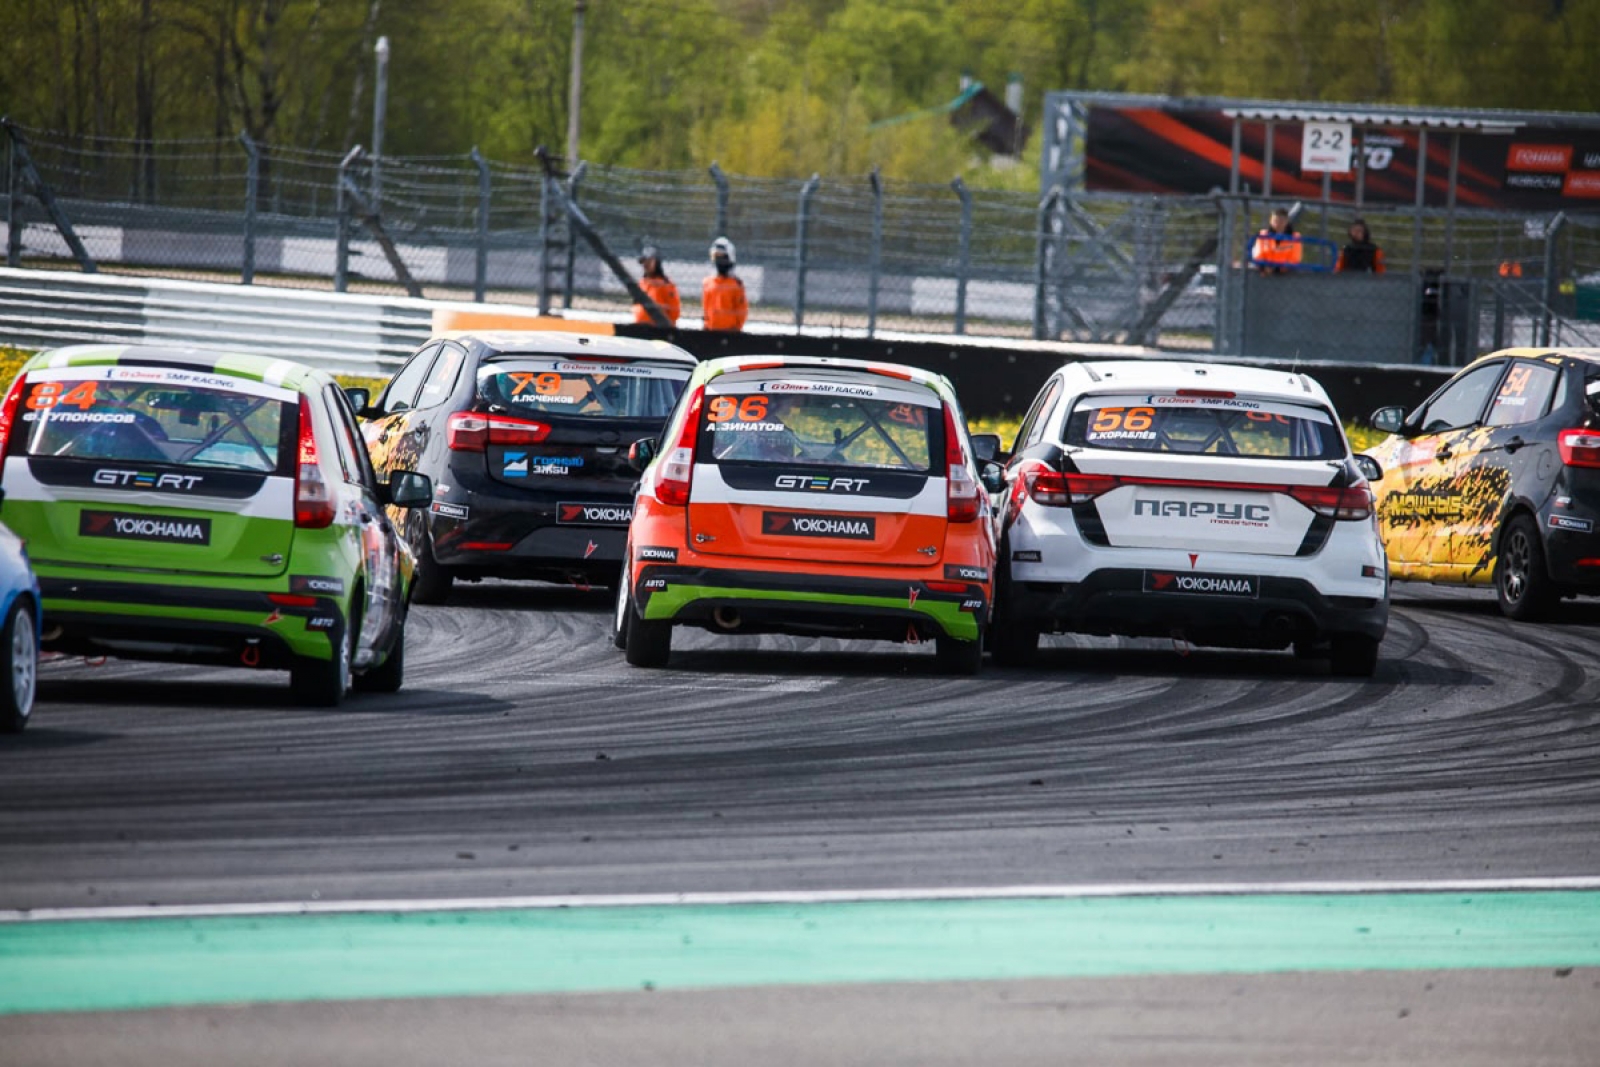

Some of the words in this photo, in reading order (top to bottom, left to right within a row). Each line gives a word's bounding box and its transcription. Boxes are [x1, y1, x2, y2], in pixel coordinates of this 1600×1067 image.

[1310, 128, 1344, 150] 2-2
[600, 364, 619, 372] SMP
[619, 366, 652, 375] RACING
[166, 372, 190, 381] SMP
[191, 376, 235, 388] RACING
[507, 372, 562, 395] 79
[25, 380, 99, 410] 84
[811, 384, 834, 392] SMP
[835, 386, 874, 397] RACING
[707, 395, 769, 423] 96
[1200, 398, 1223, 406] SMP
[1223, 400, 1260, 409] RACING
[705, 422, 785, 432] А.ЗИНАТОВ
[1092, 407, 1156, 432] 56
[583, 507, 634, 521] YOKOHA
[1134, 498, 1270, 521] ПАРУС
[113, 518, 203, 539] YOKOHAMA
[792, 518, 870, 535] YOKOHAMA
[1175, 575, 1252, 592] YOKOHAMA
